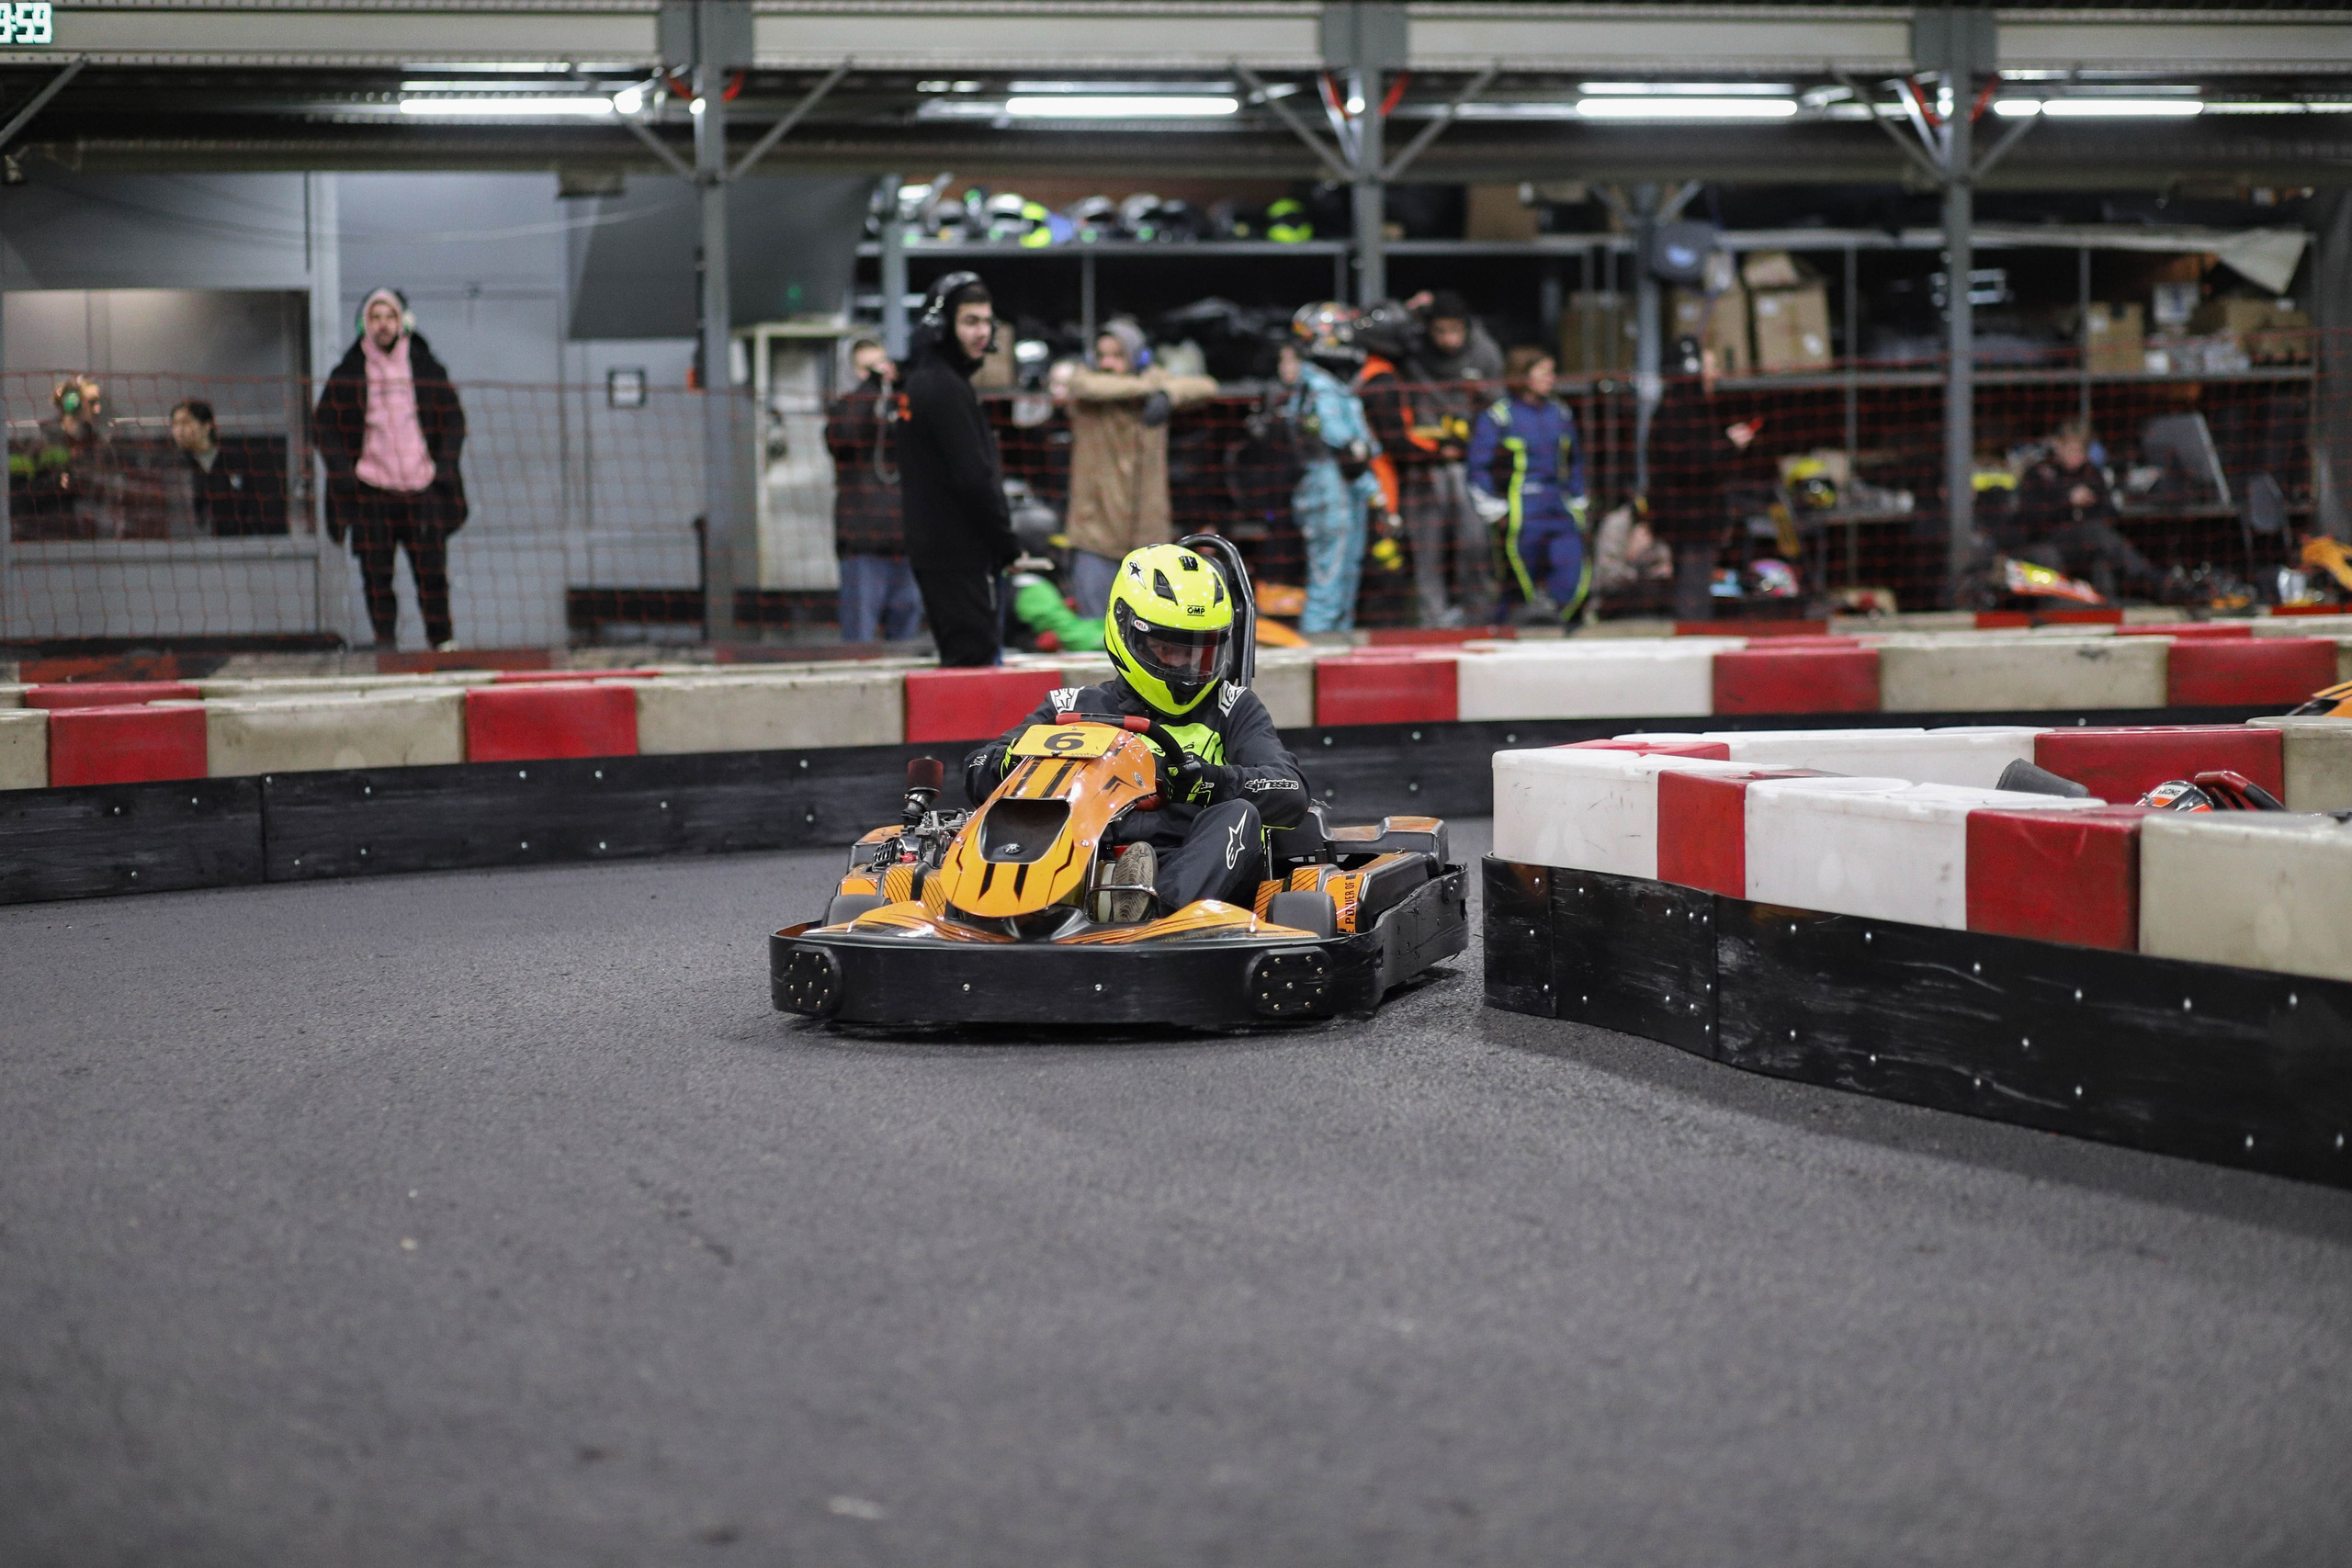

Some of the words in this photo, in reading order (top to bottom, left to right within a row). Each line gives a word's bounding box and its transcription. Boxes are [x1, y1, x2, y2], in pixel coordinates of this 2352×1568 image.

[1187, 606, 1204, 615] OMP
[1136, 621, 1148, 630] BELL
[1044, 732, 1085, 750] 6
[1244, 779, 1298, 793] alpinestars
[1344, 882, 1355, 890] OF
[1344, 890, 1355, 924] POWER
